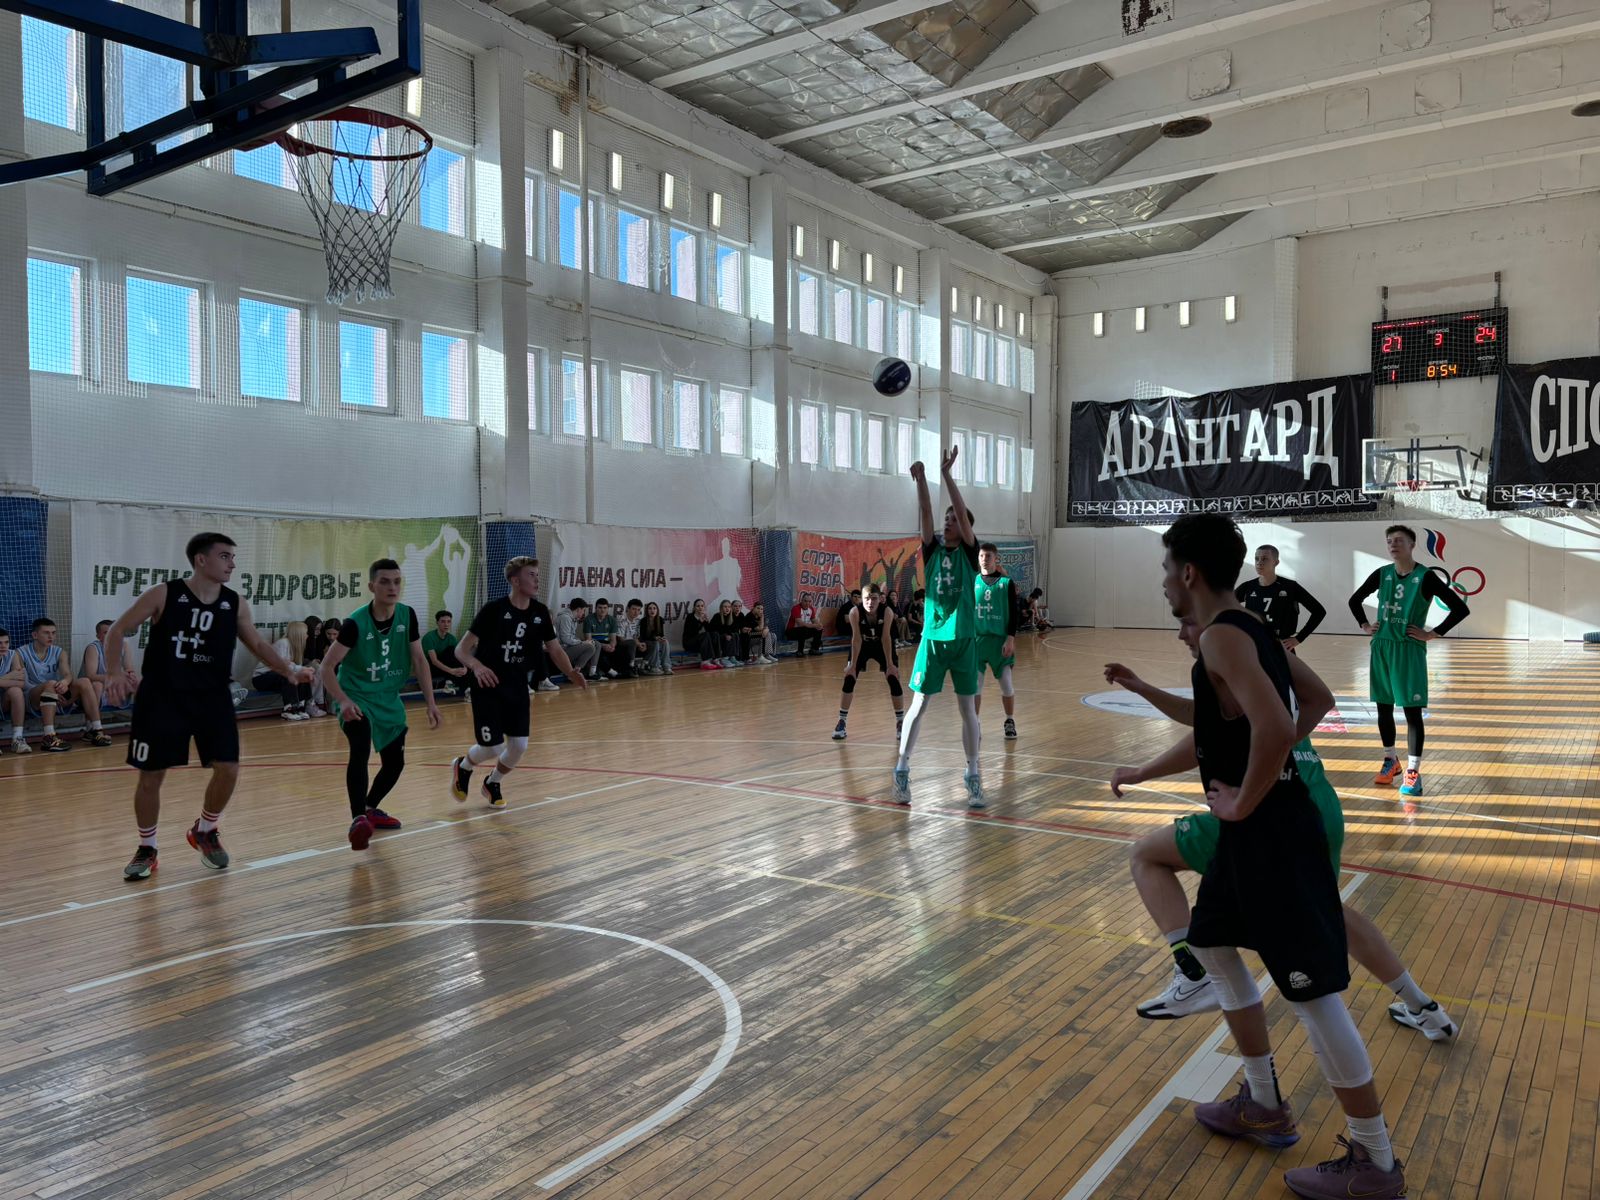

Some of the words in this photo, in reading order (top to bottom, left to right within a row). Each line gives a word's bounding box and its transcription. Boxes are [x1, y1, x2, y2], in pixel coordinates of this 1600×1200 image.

[1434, 333, 1443, 346] 3
[1475, 327, 1496, 344] 24
[1383, 336, 1402, 353] 27
[1427, 364, 1458, 379] 8:54
[1098, 386, 1340, 487] АВАНГАРД
[942, 555, 952, 570] 4
[631, 568, 667, 588] СИЛА
[800, 570, 841, 588] ВЫБОР
[241, 572, 362, 605] ЗДОРОВЬЕ
[984, 589, 992, 601] 8
[1394, 583, 1405, 599] 3
[1263, 598, 1273, 612] 7
[191, 608, 215, 632] 10
[515, 622, 527, 638] 6
[381, 638, 390, 656] 5
[481, 725, 492, 743] 6
[132, 738, 150, 763] 10
